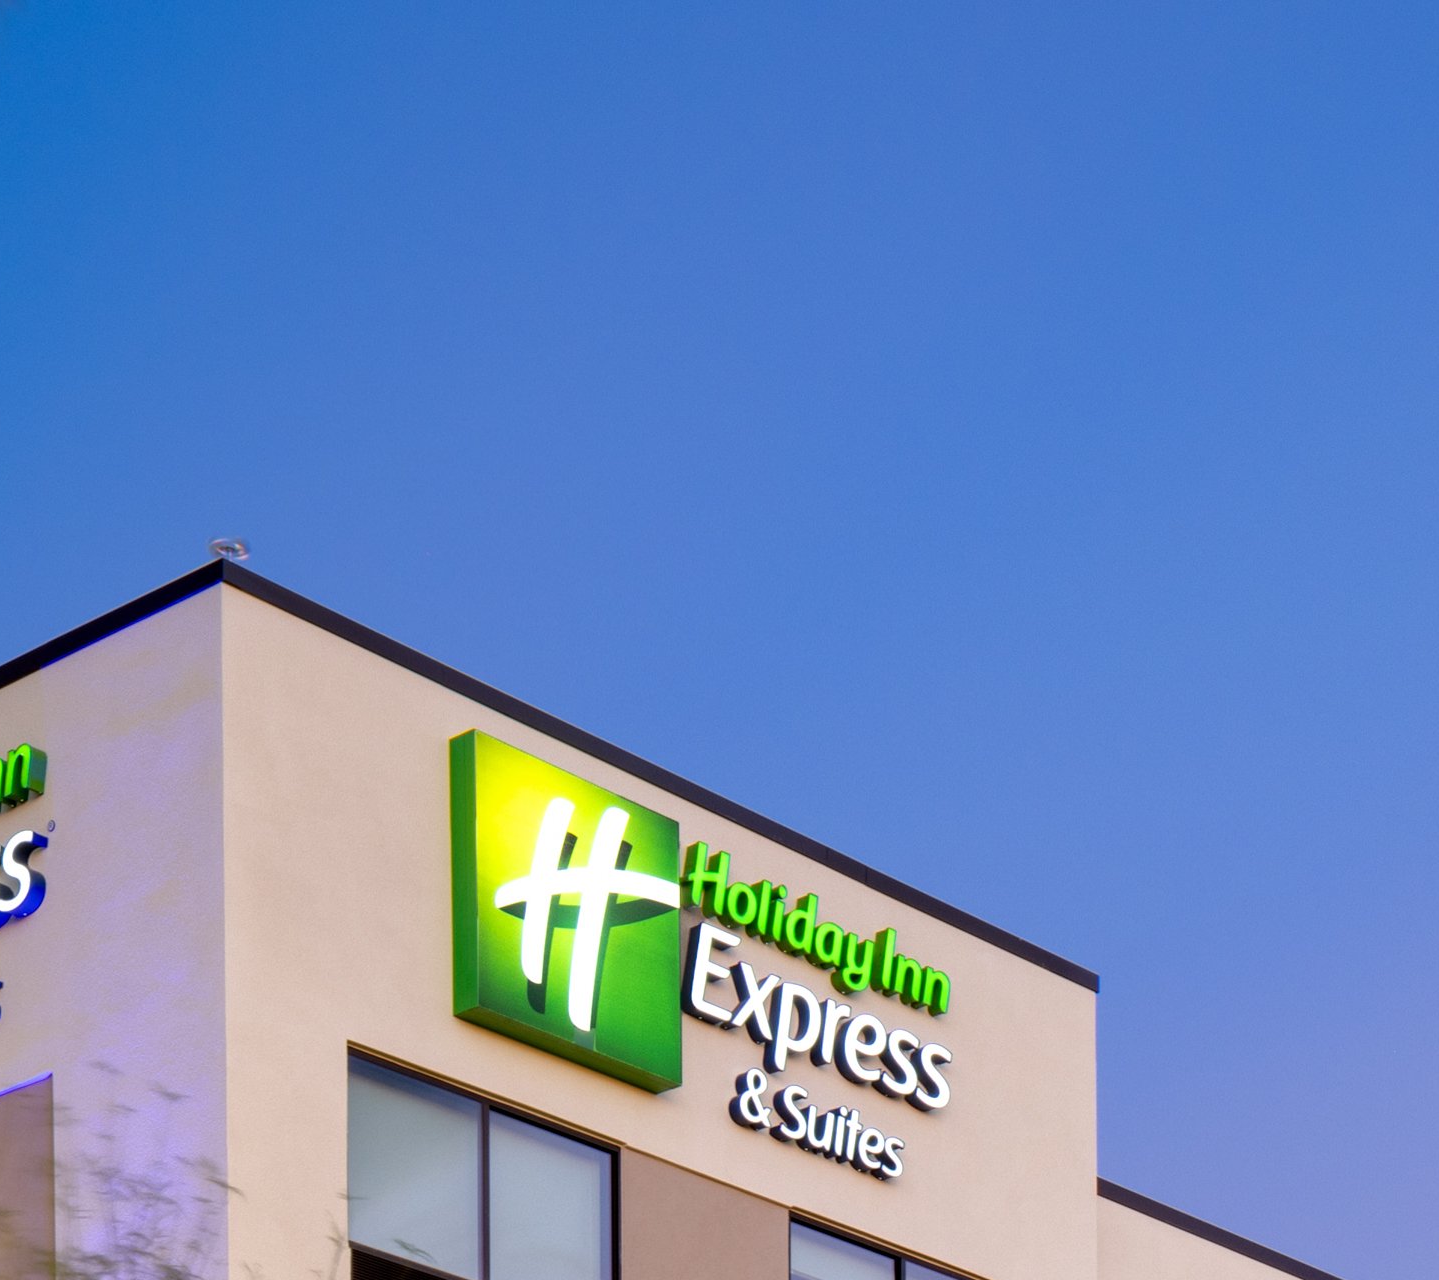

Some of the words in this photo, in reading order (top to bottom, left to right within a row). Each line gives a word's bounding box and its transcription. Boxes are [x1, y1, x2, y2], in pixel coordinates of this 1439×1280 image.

[685, 841, 875, 993] Holiday
[878, 927, 952, 1015] Inn
[686, 922, 952, 1110] Express
[733, 1067, 771, 1126] &
[775, 1084, 905, 1178] Suites
